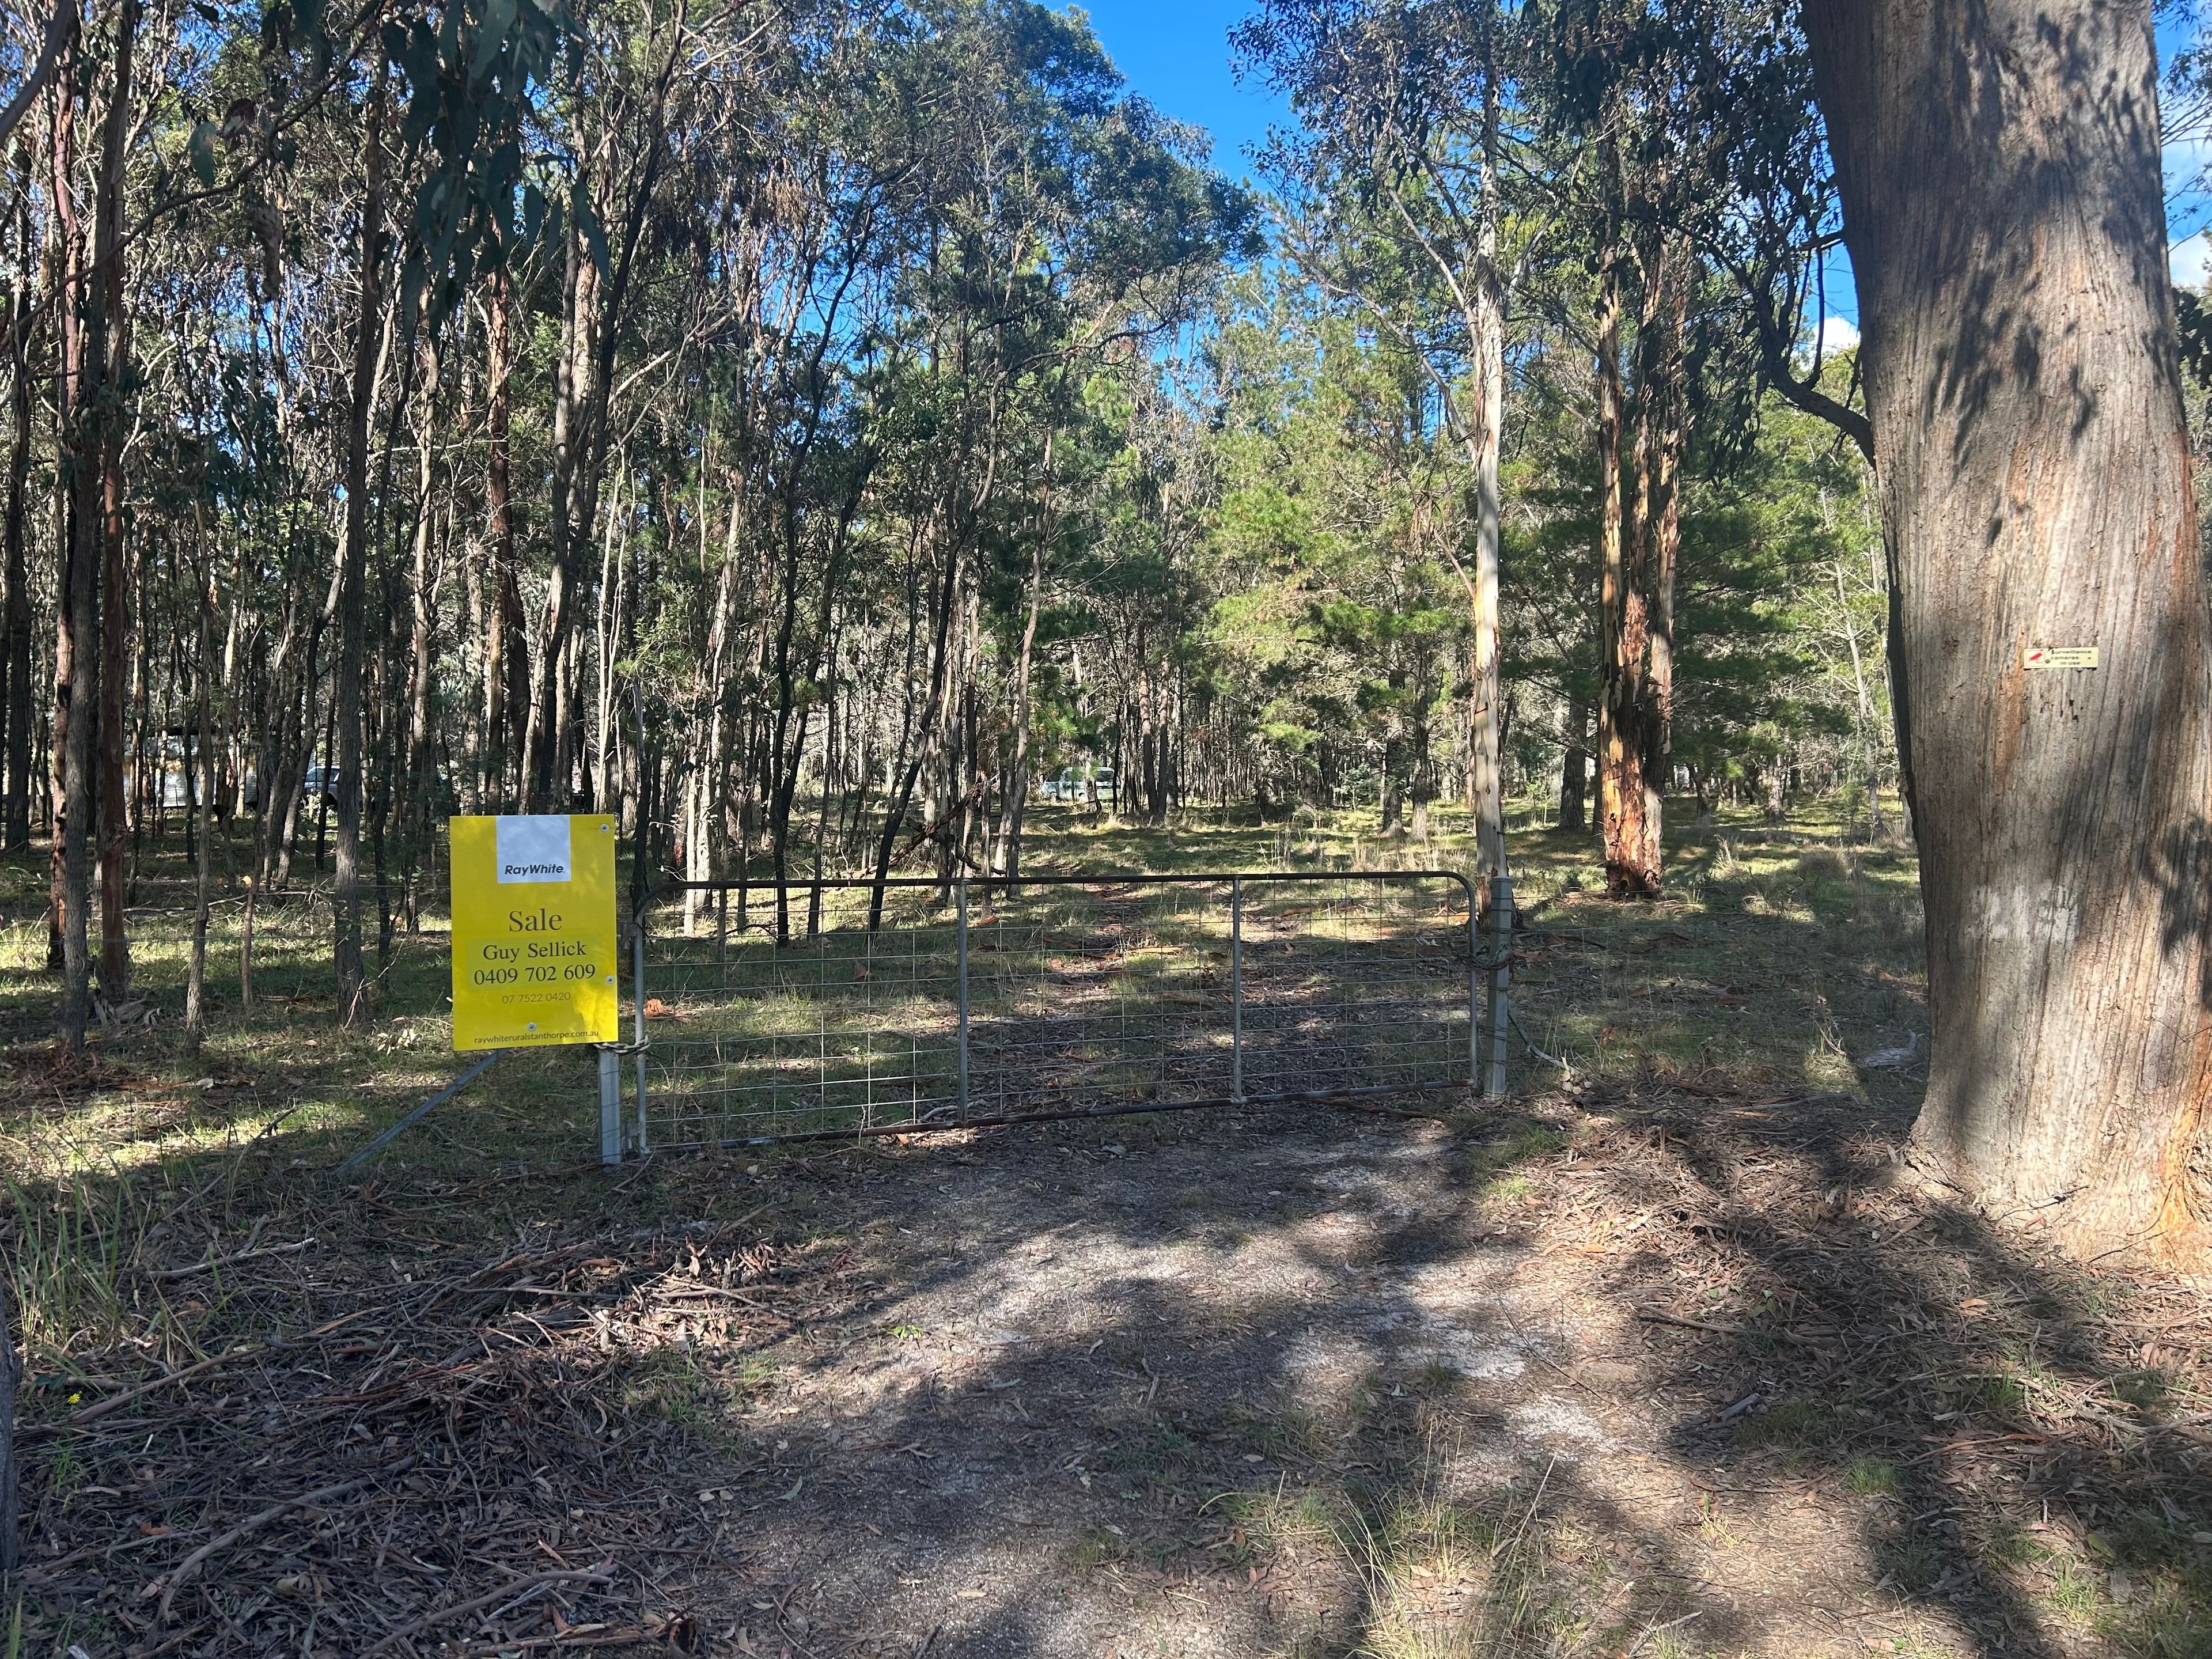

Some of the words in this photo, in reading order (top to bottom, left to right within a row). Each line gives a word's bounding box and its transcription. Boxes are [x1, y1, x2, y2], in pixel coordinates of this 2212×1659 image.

[509, 908, 562, 933] Sale
[483, 945, 520, 963] Guy
[528, 941, 587, 958] Sellick
[474, 968, 518, 985] 0409
[525, 966, 557, 982] 702
[564, 964, 596, 980] 609
[502, 995, 514, 1004] 07
[518, 994, 543, 1003] 7522
[546, 992, 571, 1001] 0420
[474, 1030, 599, 1044] raywhiteruralstanthorpe.com.au
